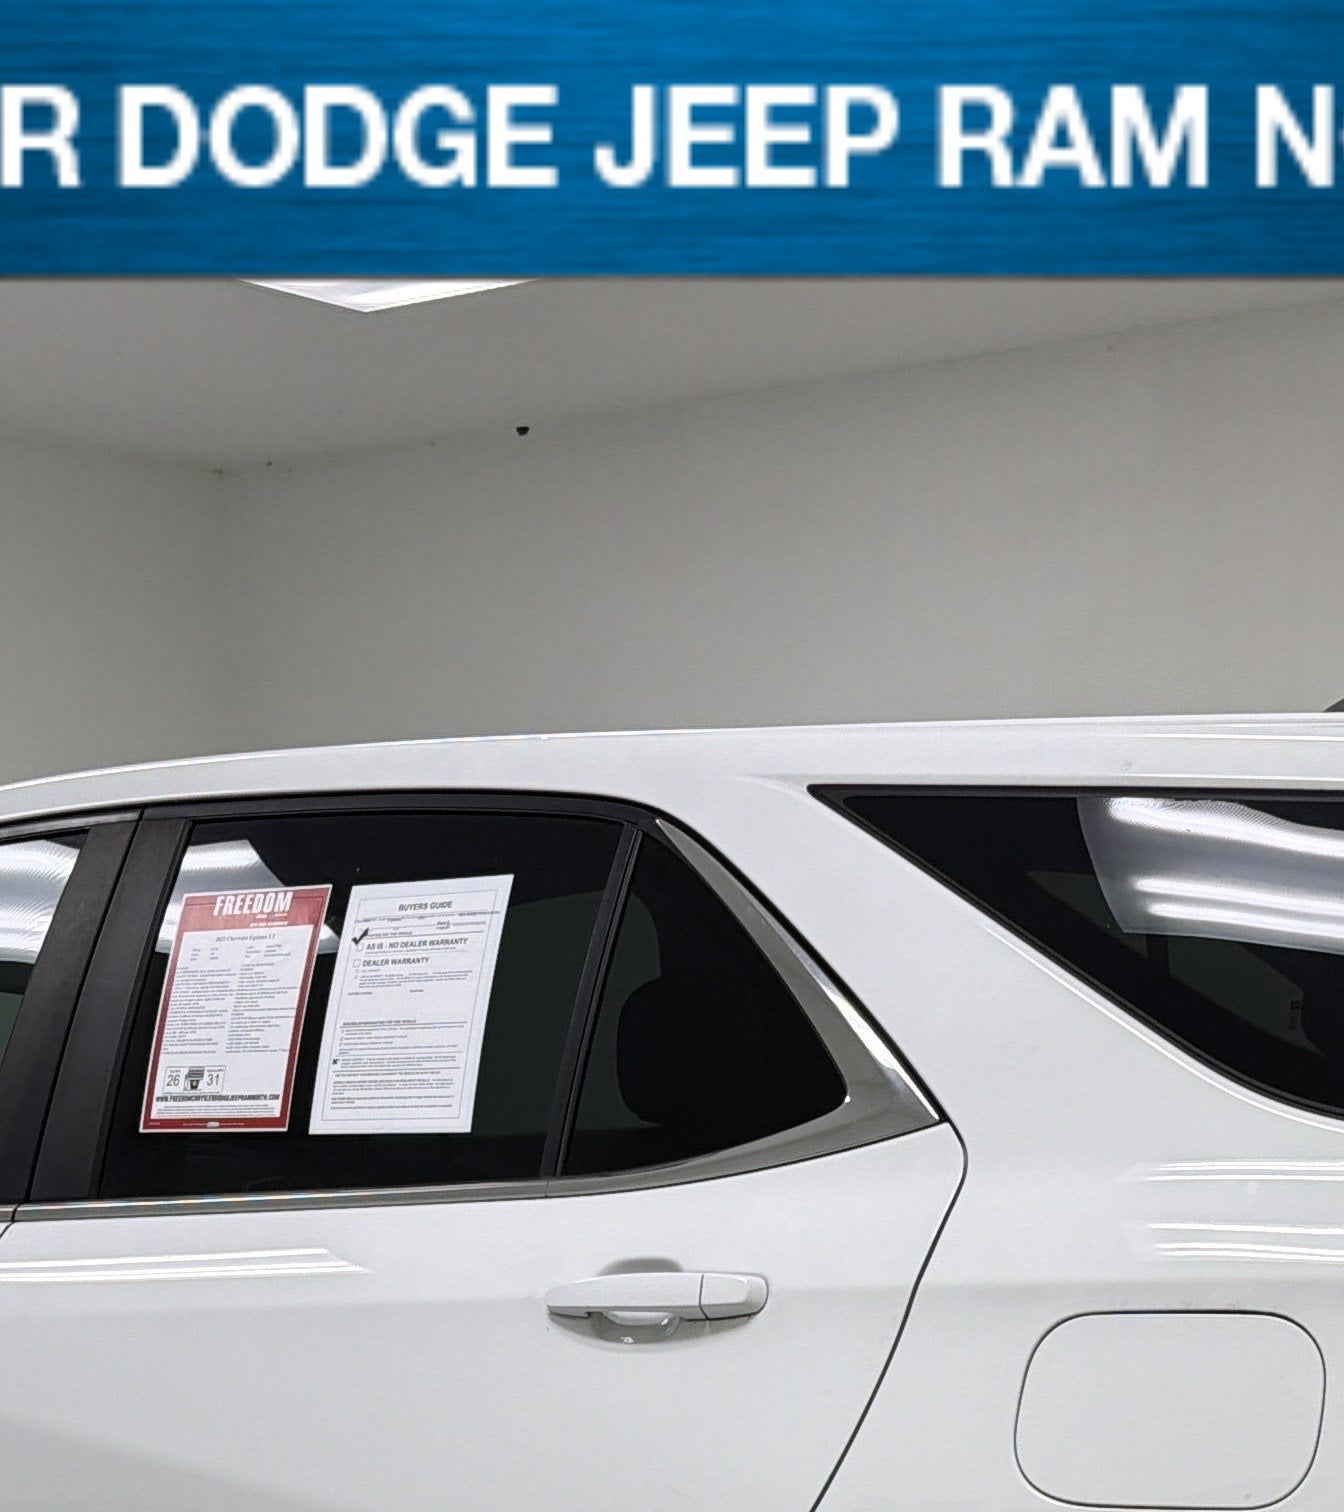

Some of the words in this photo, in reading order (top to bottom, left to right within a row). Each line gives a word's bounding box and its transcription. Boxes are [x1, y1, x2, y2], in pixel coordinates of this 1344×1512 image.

[213, 891, 294, 917] FREEDOM
[398, 902, 429, 912] BUYERS
[430, 900, 454, 910] GUIDE
[365, 942, 376, 950] AS
[388, 941, 399, 949] NO
[400, 940, 428, 949] DEALER
[428, 937, 469, 947] WARRANTY
[362, 958, 390, 967] DEALER
[391, 956, 430, 966] WARRANTY
[166, 1074, 181, 1087] 26
[206, 1073, 220, 1087] 31
